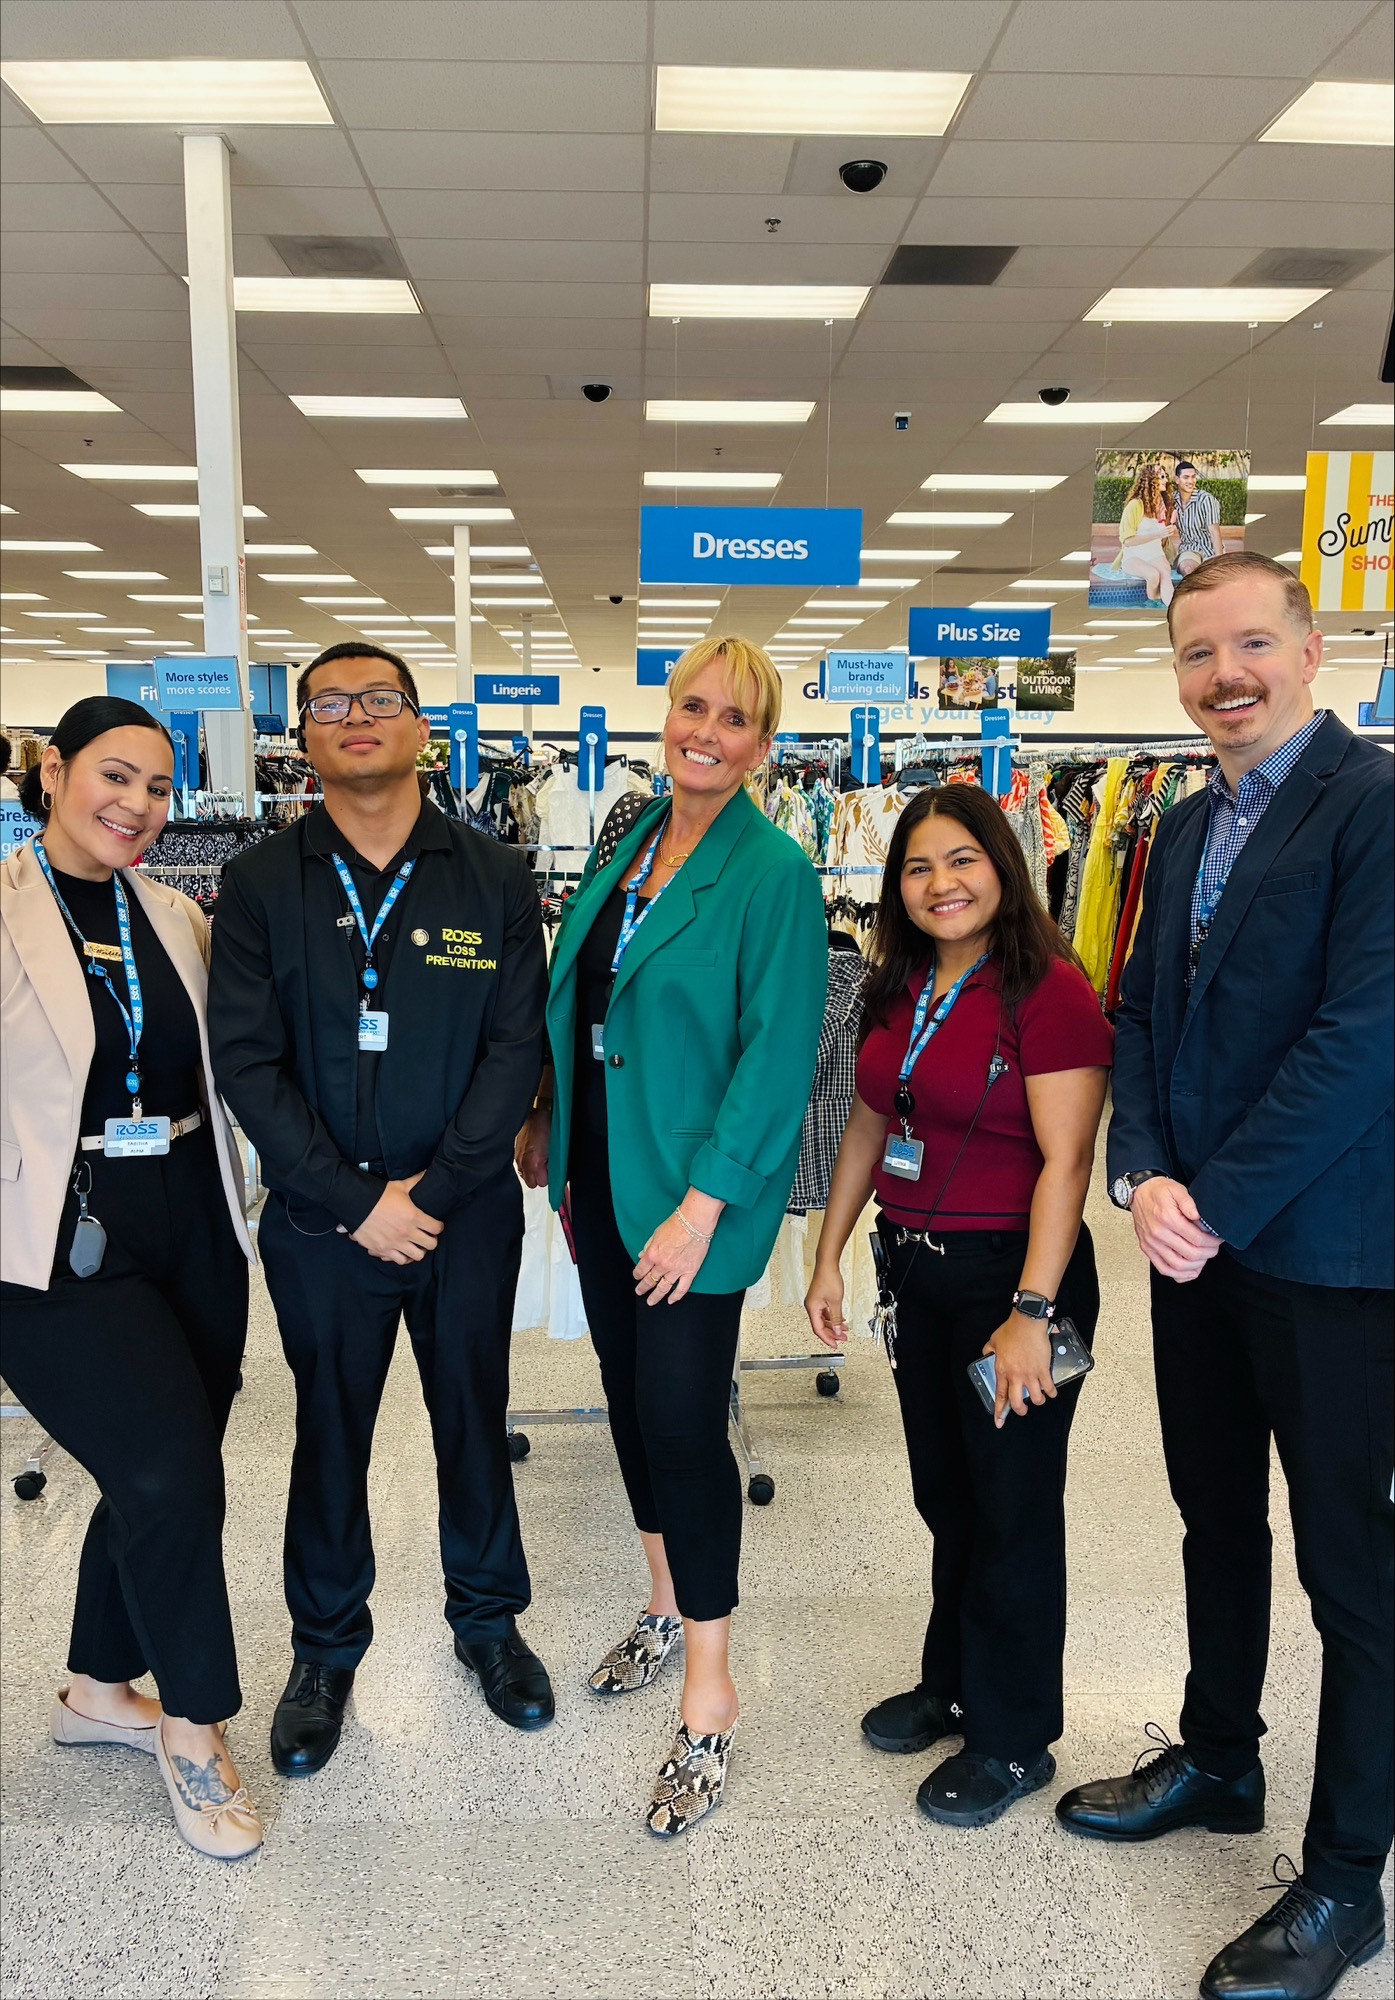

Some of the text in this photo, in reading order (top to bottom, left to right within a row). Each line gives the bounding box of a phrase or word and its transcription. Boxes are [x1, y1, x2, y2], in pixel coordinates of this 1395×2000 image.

[693, 532, 808, 560] Dresses
[1351, 555, 1394, 570] SHO
[937, 623, 1021, 642] Plus Size
[837, 659, 894, 669] Must-have
[165, 672, 229, 684] More styles
[848, 671, 885, 681] brands
[1022, 675, 1071, 685] OUTDOOR
[166, 686, 231, 695] more scores
[492, 684, 542, 698] Lingerie
[831, 683, 873, 696] arriving
[875, 684, 901, 696] daily
[1030, 685, 1062, 694] LIVING
[879, 703, 914, 725] get
[13, 827, 34, 841] go
[442, 928, 482, 944] ROSS
[446, 944, 476, 957] LOSS
[426, 954, 497, 970] PREVENTION
[359, 1019, 378, 1030] SS
[116, 1123, 158, 1136] ROSS
